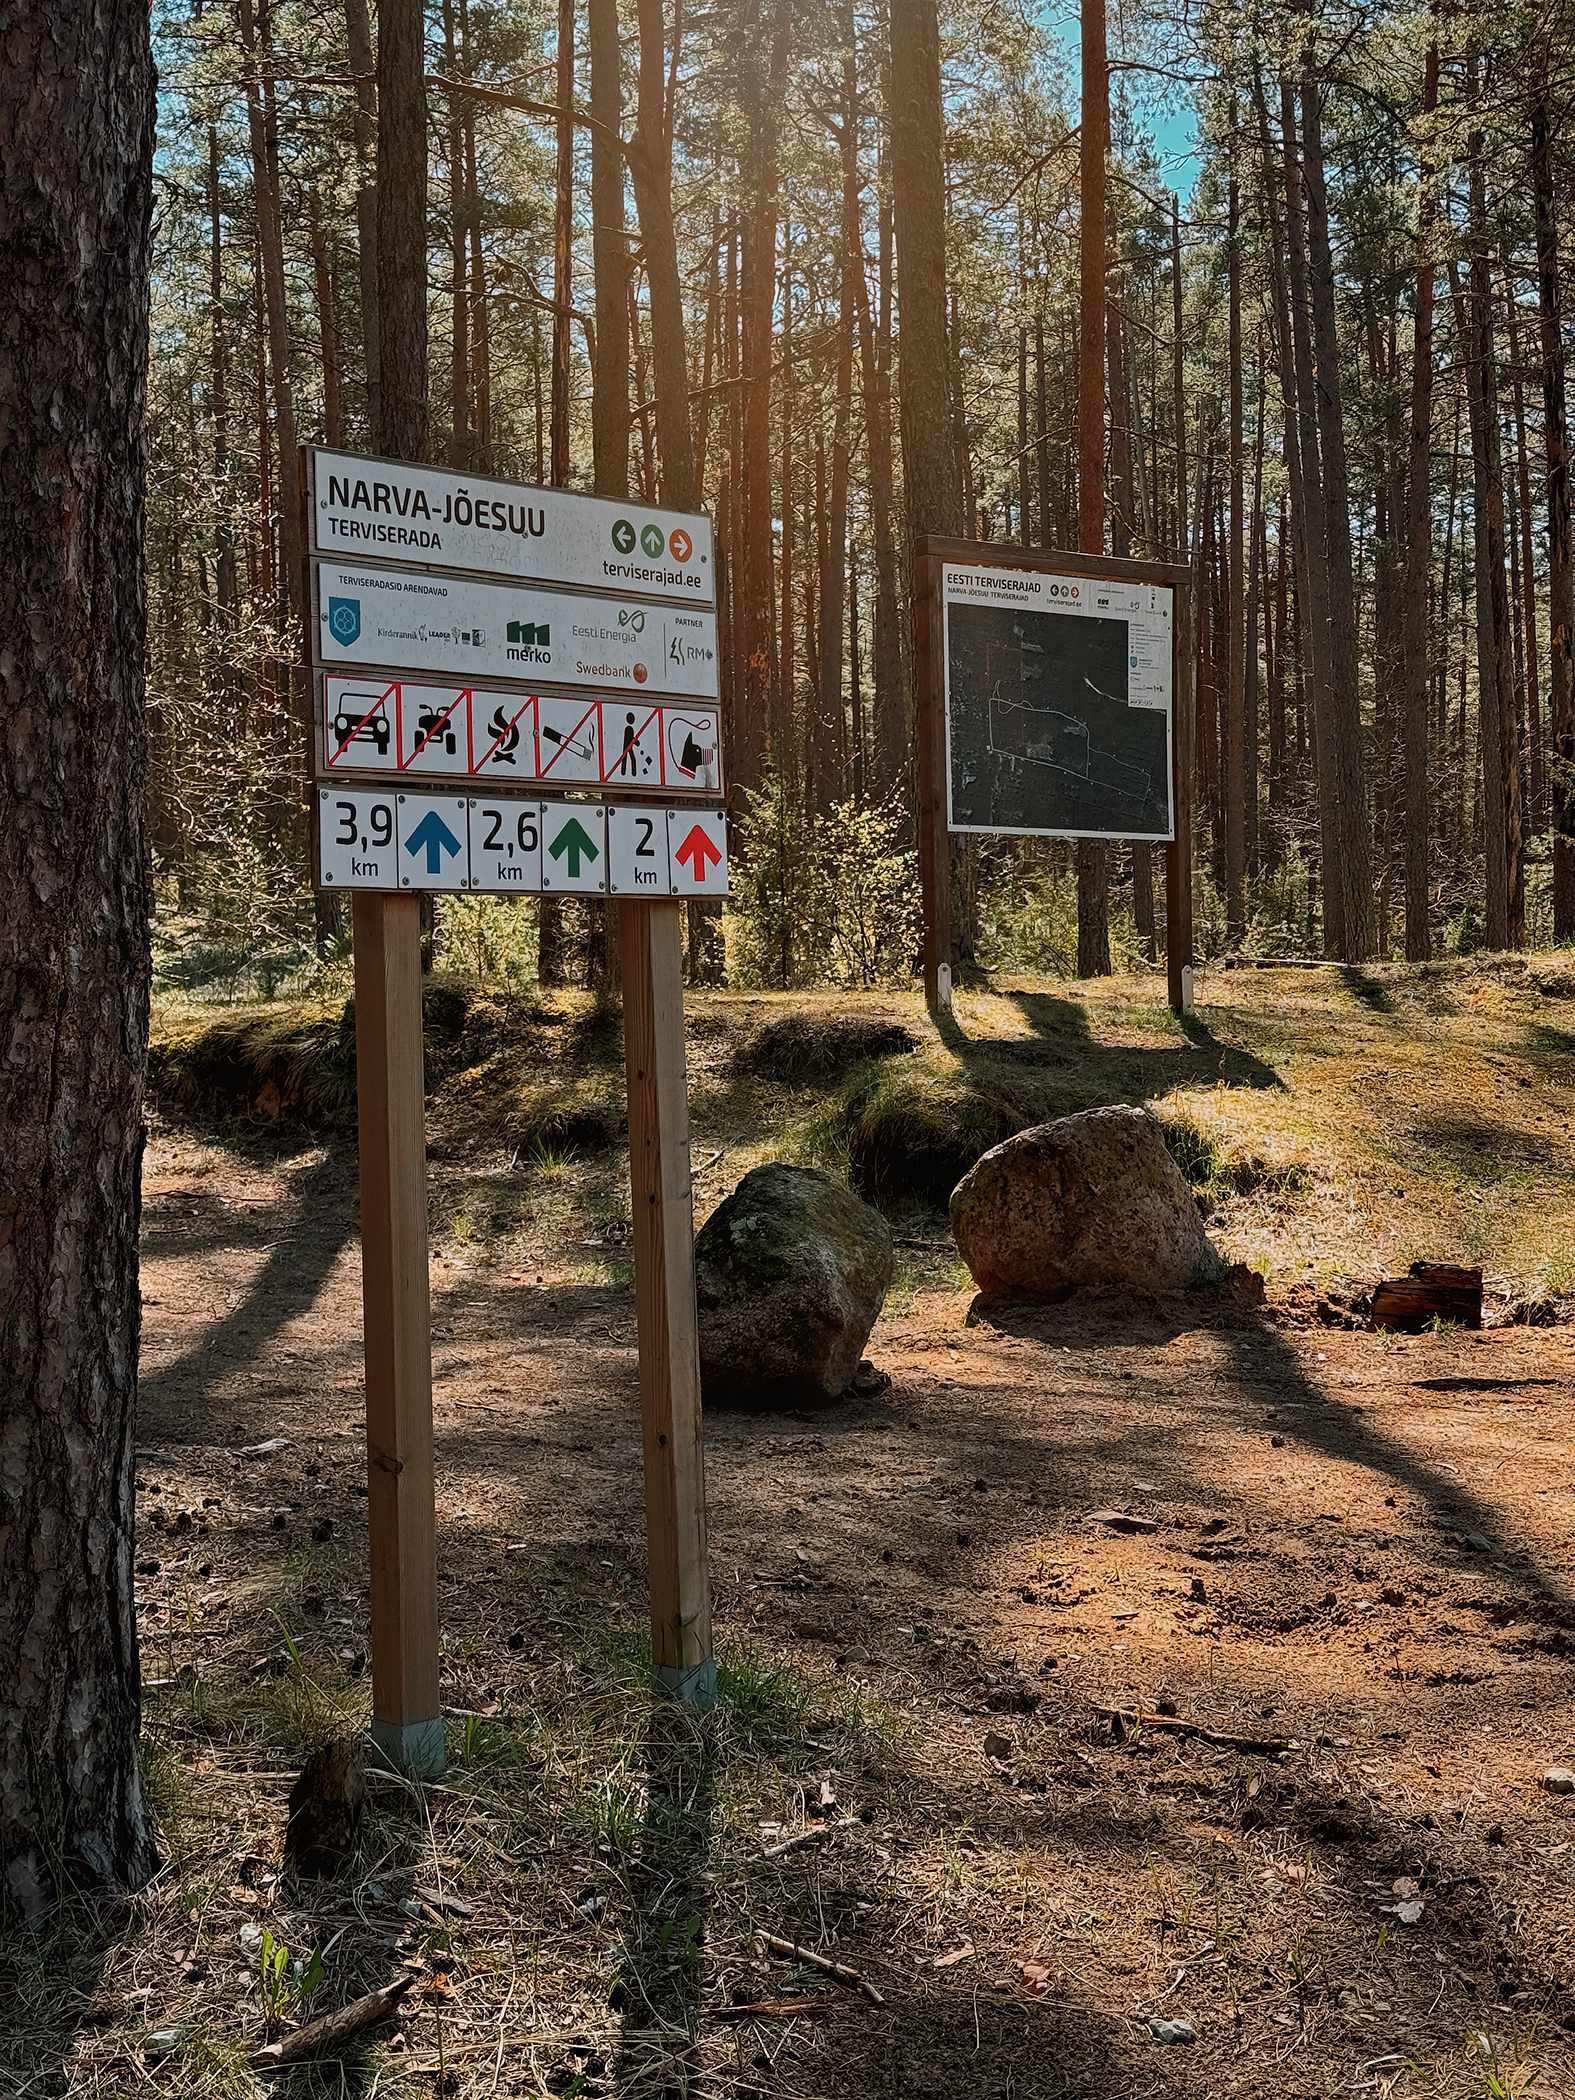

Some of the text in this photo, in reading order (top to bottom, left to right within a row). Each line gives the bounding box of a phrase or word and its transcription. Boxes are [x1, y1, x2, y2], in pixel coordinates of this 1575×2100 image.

[328, 475, 546, 538] NARVA-JÕESUU
[328, 517, 442, 550] TERVISERADA
[602, 560, 702, 589] terviserajad.ee
[947, 573, 1041, 593] EESTI TERVISERAJAD
[403, 583, 448, 597] ARENDAVAD
[990, 591, 1029, 602] TERVISERAJAD
[675, 617, 703, 628] PARTNER
[428, 630, 450, 639] LEADER
[572, 625, 637, 644] Eesti Energia
[506, 646, 552, 665] merko
[686, 646, 713, 661] RM
[576, 661, 632, 679] Swedbank
[335, 801, 393, 854] 3,9
[481, 809, 539, 859] 2,6
[634, 817, 656, 857] 2
[351, 857, 379, 877] km
[497, 862, 523, 881] km
[634, 866, 658, 885] km
